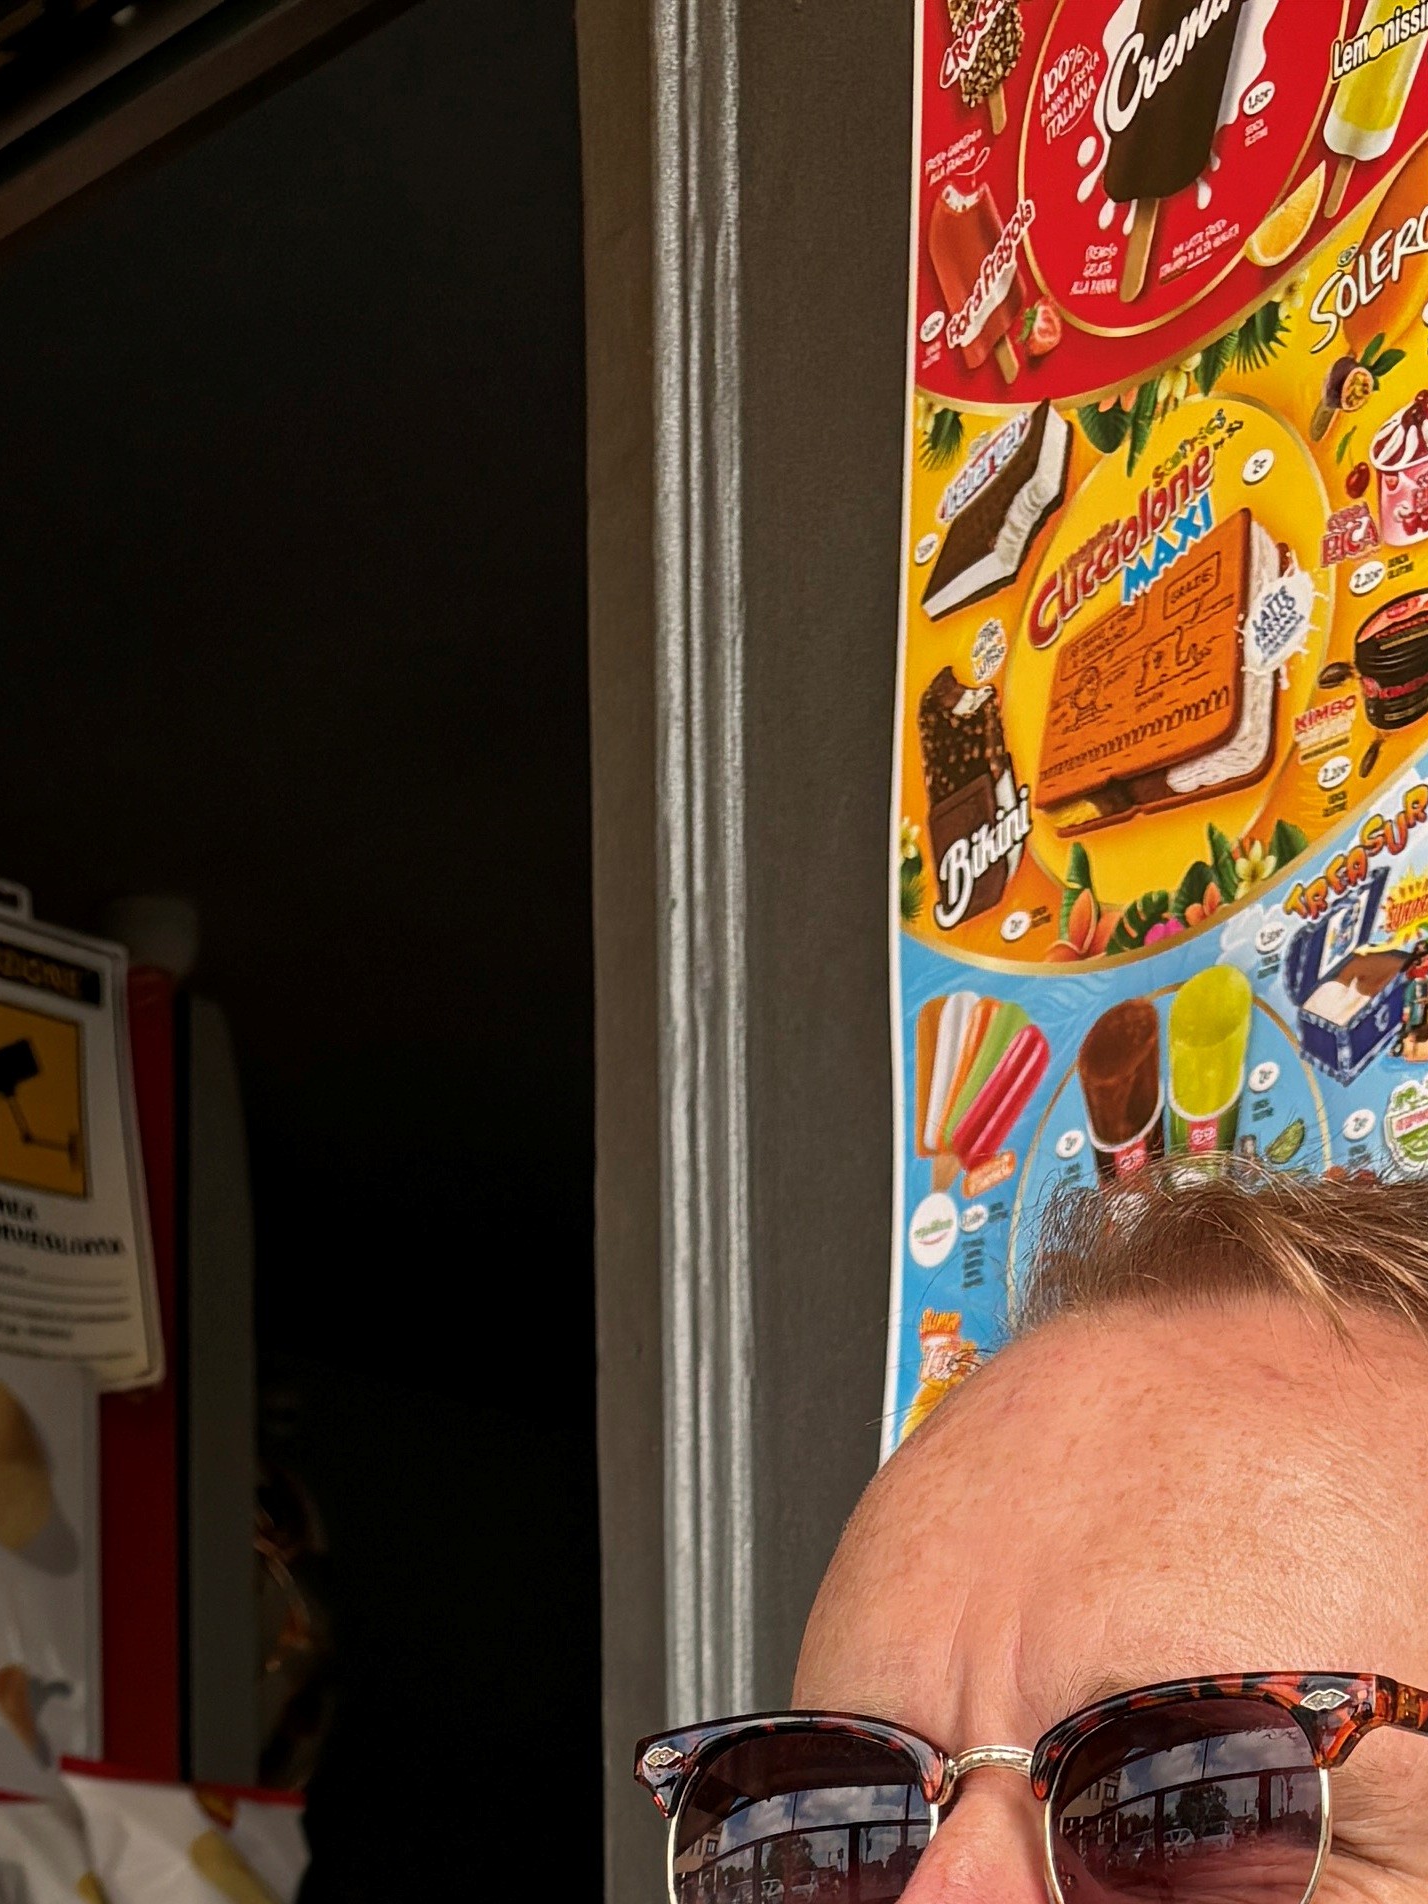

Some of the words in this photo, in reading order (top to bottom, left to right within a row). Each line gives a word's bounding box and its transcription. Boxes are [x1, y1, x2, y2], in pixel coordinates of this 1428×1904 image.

[1043, 43, 1084, 103] 100%
[1046, 75, 1097, 145] ITALIANA
[1028, 445, 1214, 648] Cucciolone
[1121, 491, 1214, 606] MAXI
[1295, 695, 1356, 733] KIMBO
[935, 784, 1032, 929] Bikini
